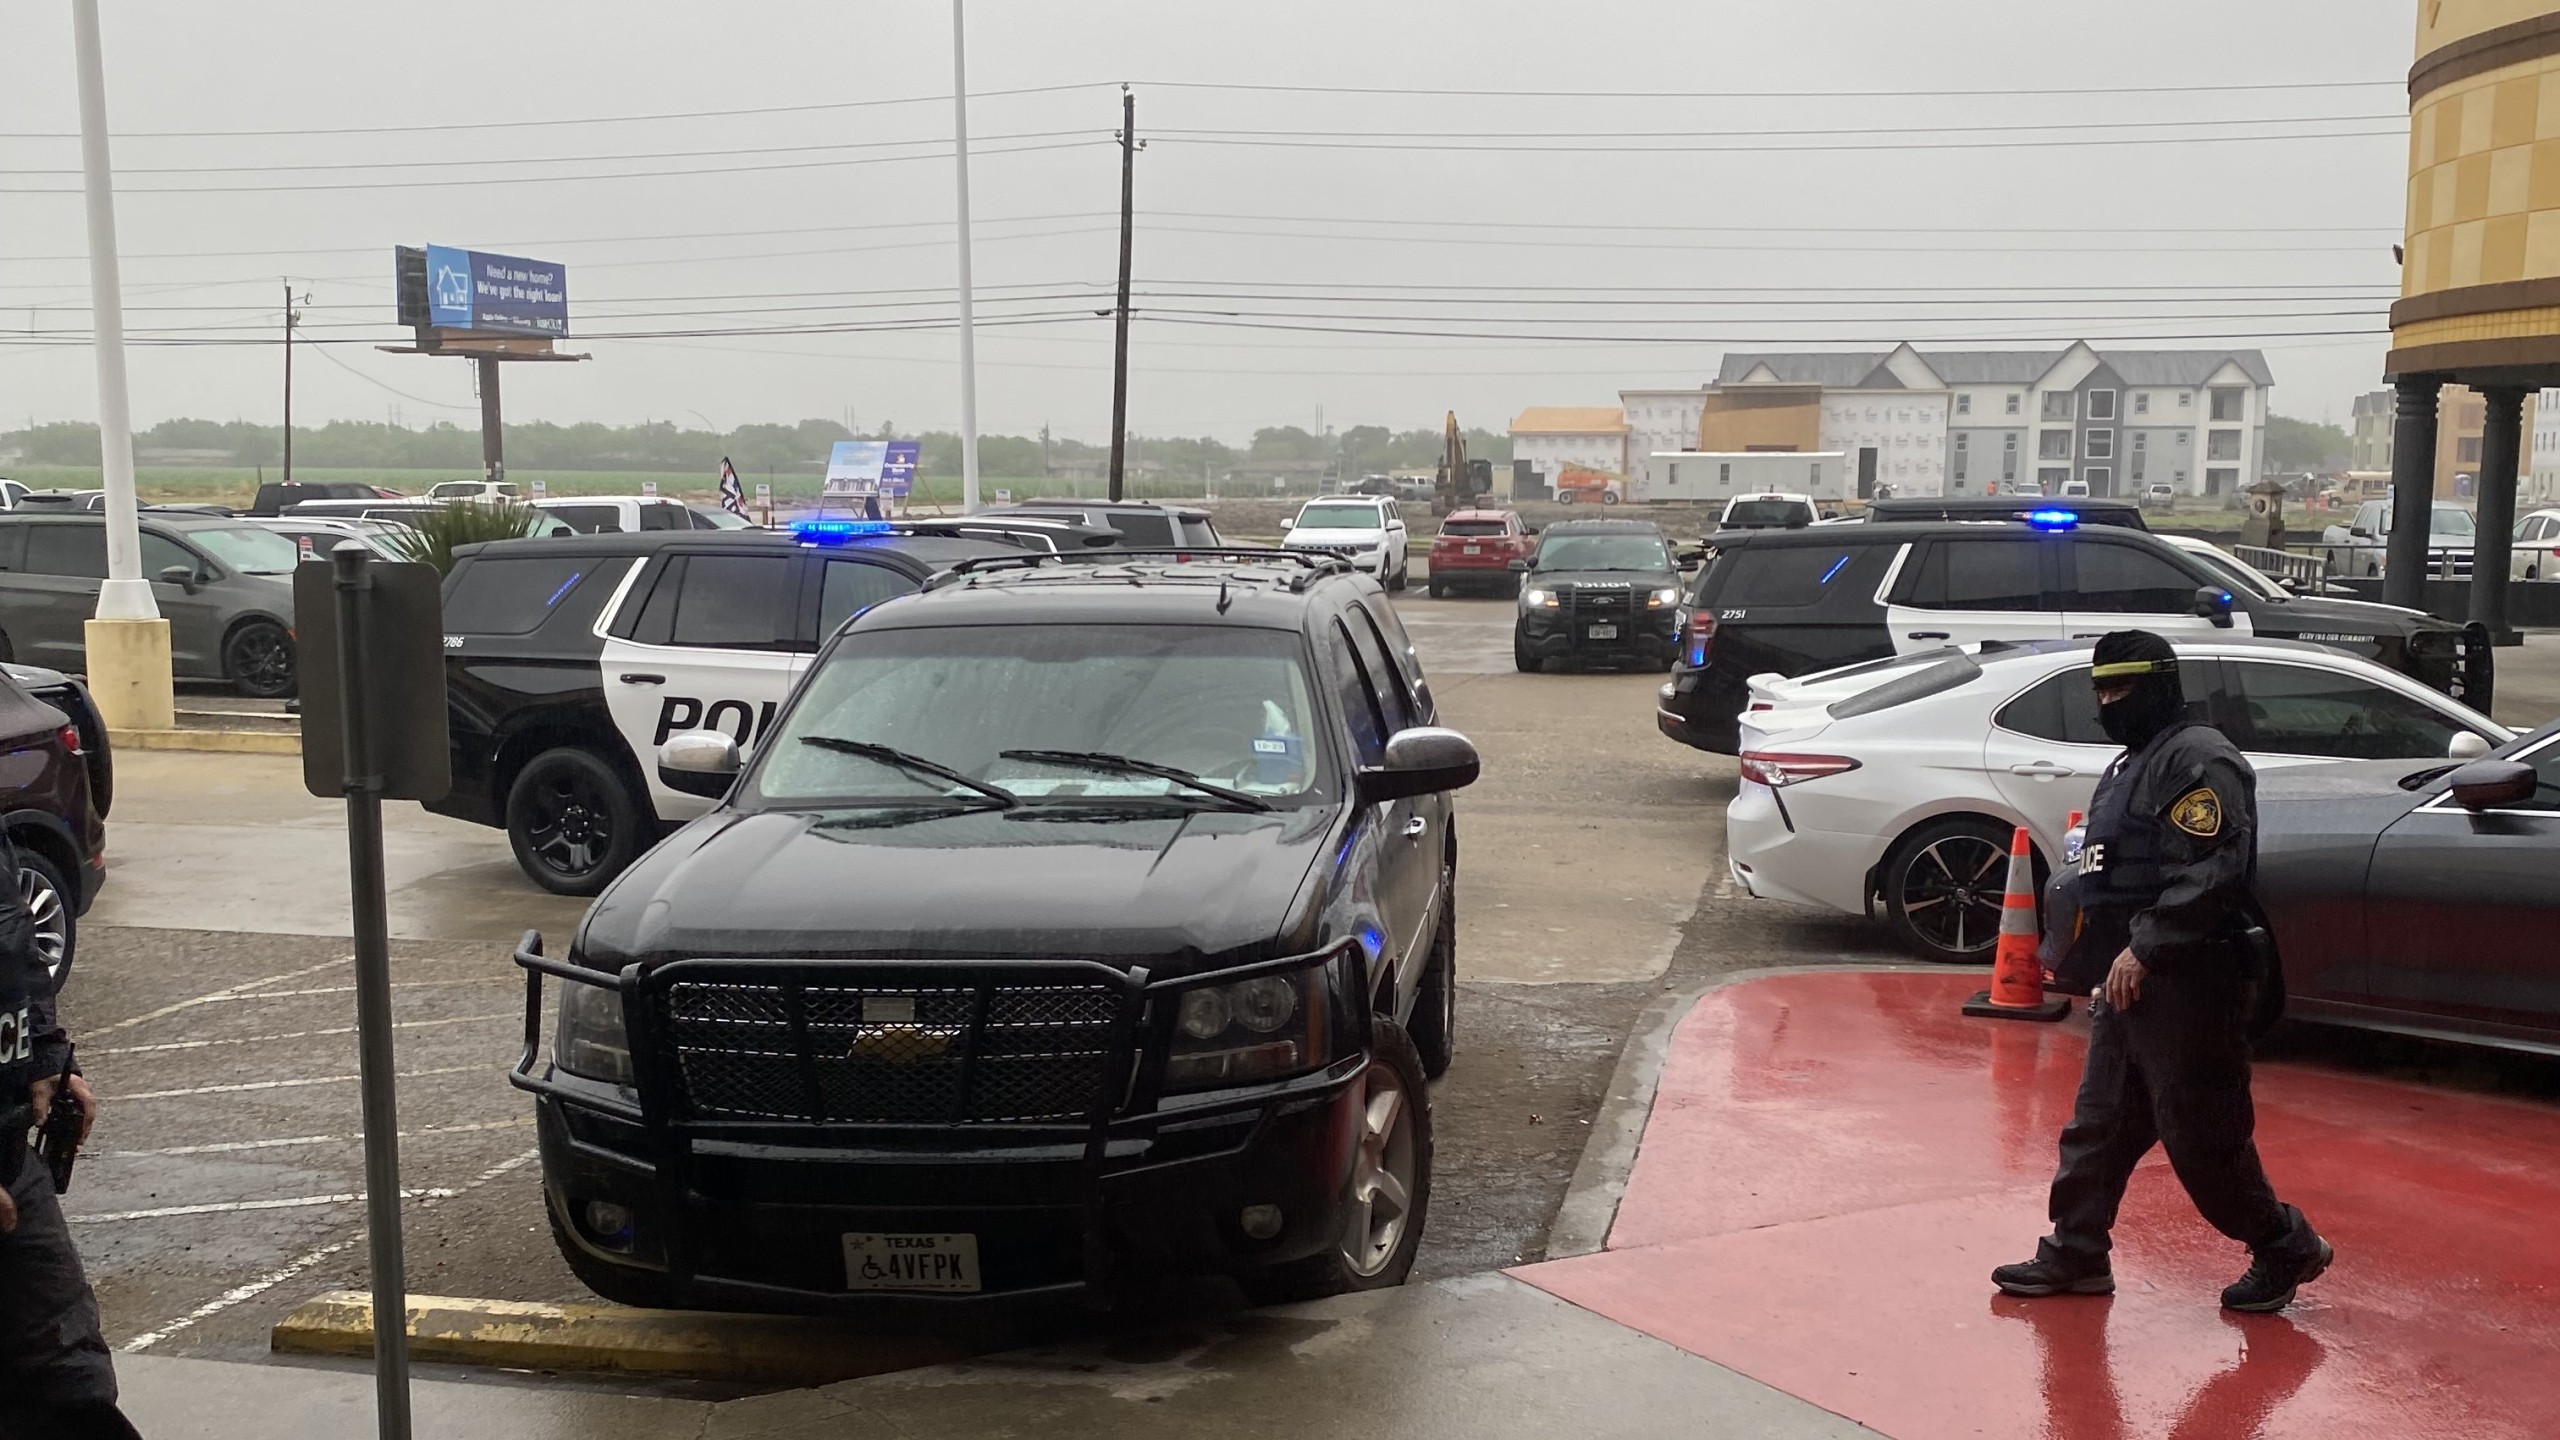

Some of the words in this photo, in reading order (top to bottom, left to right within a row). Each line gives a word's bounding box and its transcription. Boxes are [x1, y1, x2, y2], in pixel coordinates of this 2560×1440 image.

[486, 265, 506, 279] Need
[507, 270, 512, 280] a
[513, 270, 528, 282] new
[529, 269, 554, 285] home?
[476, 280, 498, 295] We've
[499, 286, 512, 300] got
[513, 285, 525, 299] the
[526, 287, 544, 304] right
[544, 289, 563, 303] loan!
[1721, 609, 1747, 620] 2751
[2298, 632, 2326, 641] SERVING
[2340, 634, 2375, 643] COMMUNITY
[2079, 844, 2105, 875] LICE
[884, 1237, 936, 1249] TEXAS
[889, 1253, 963, 1280] 4VFPK
